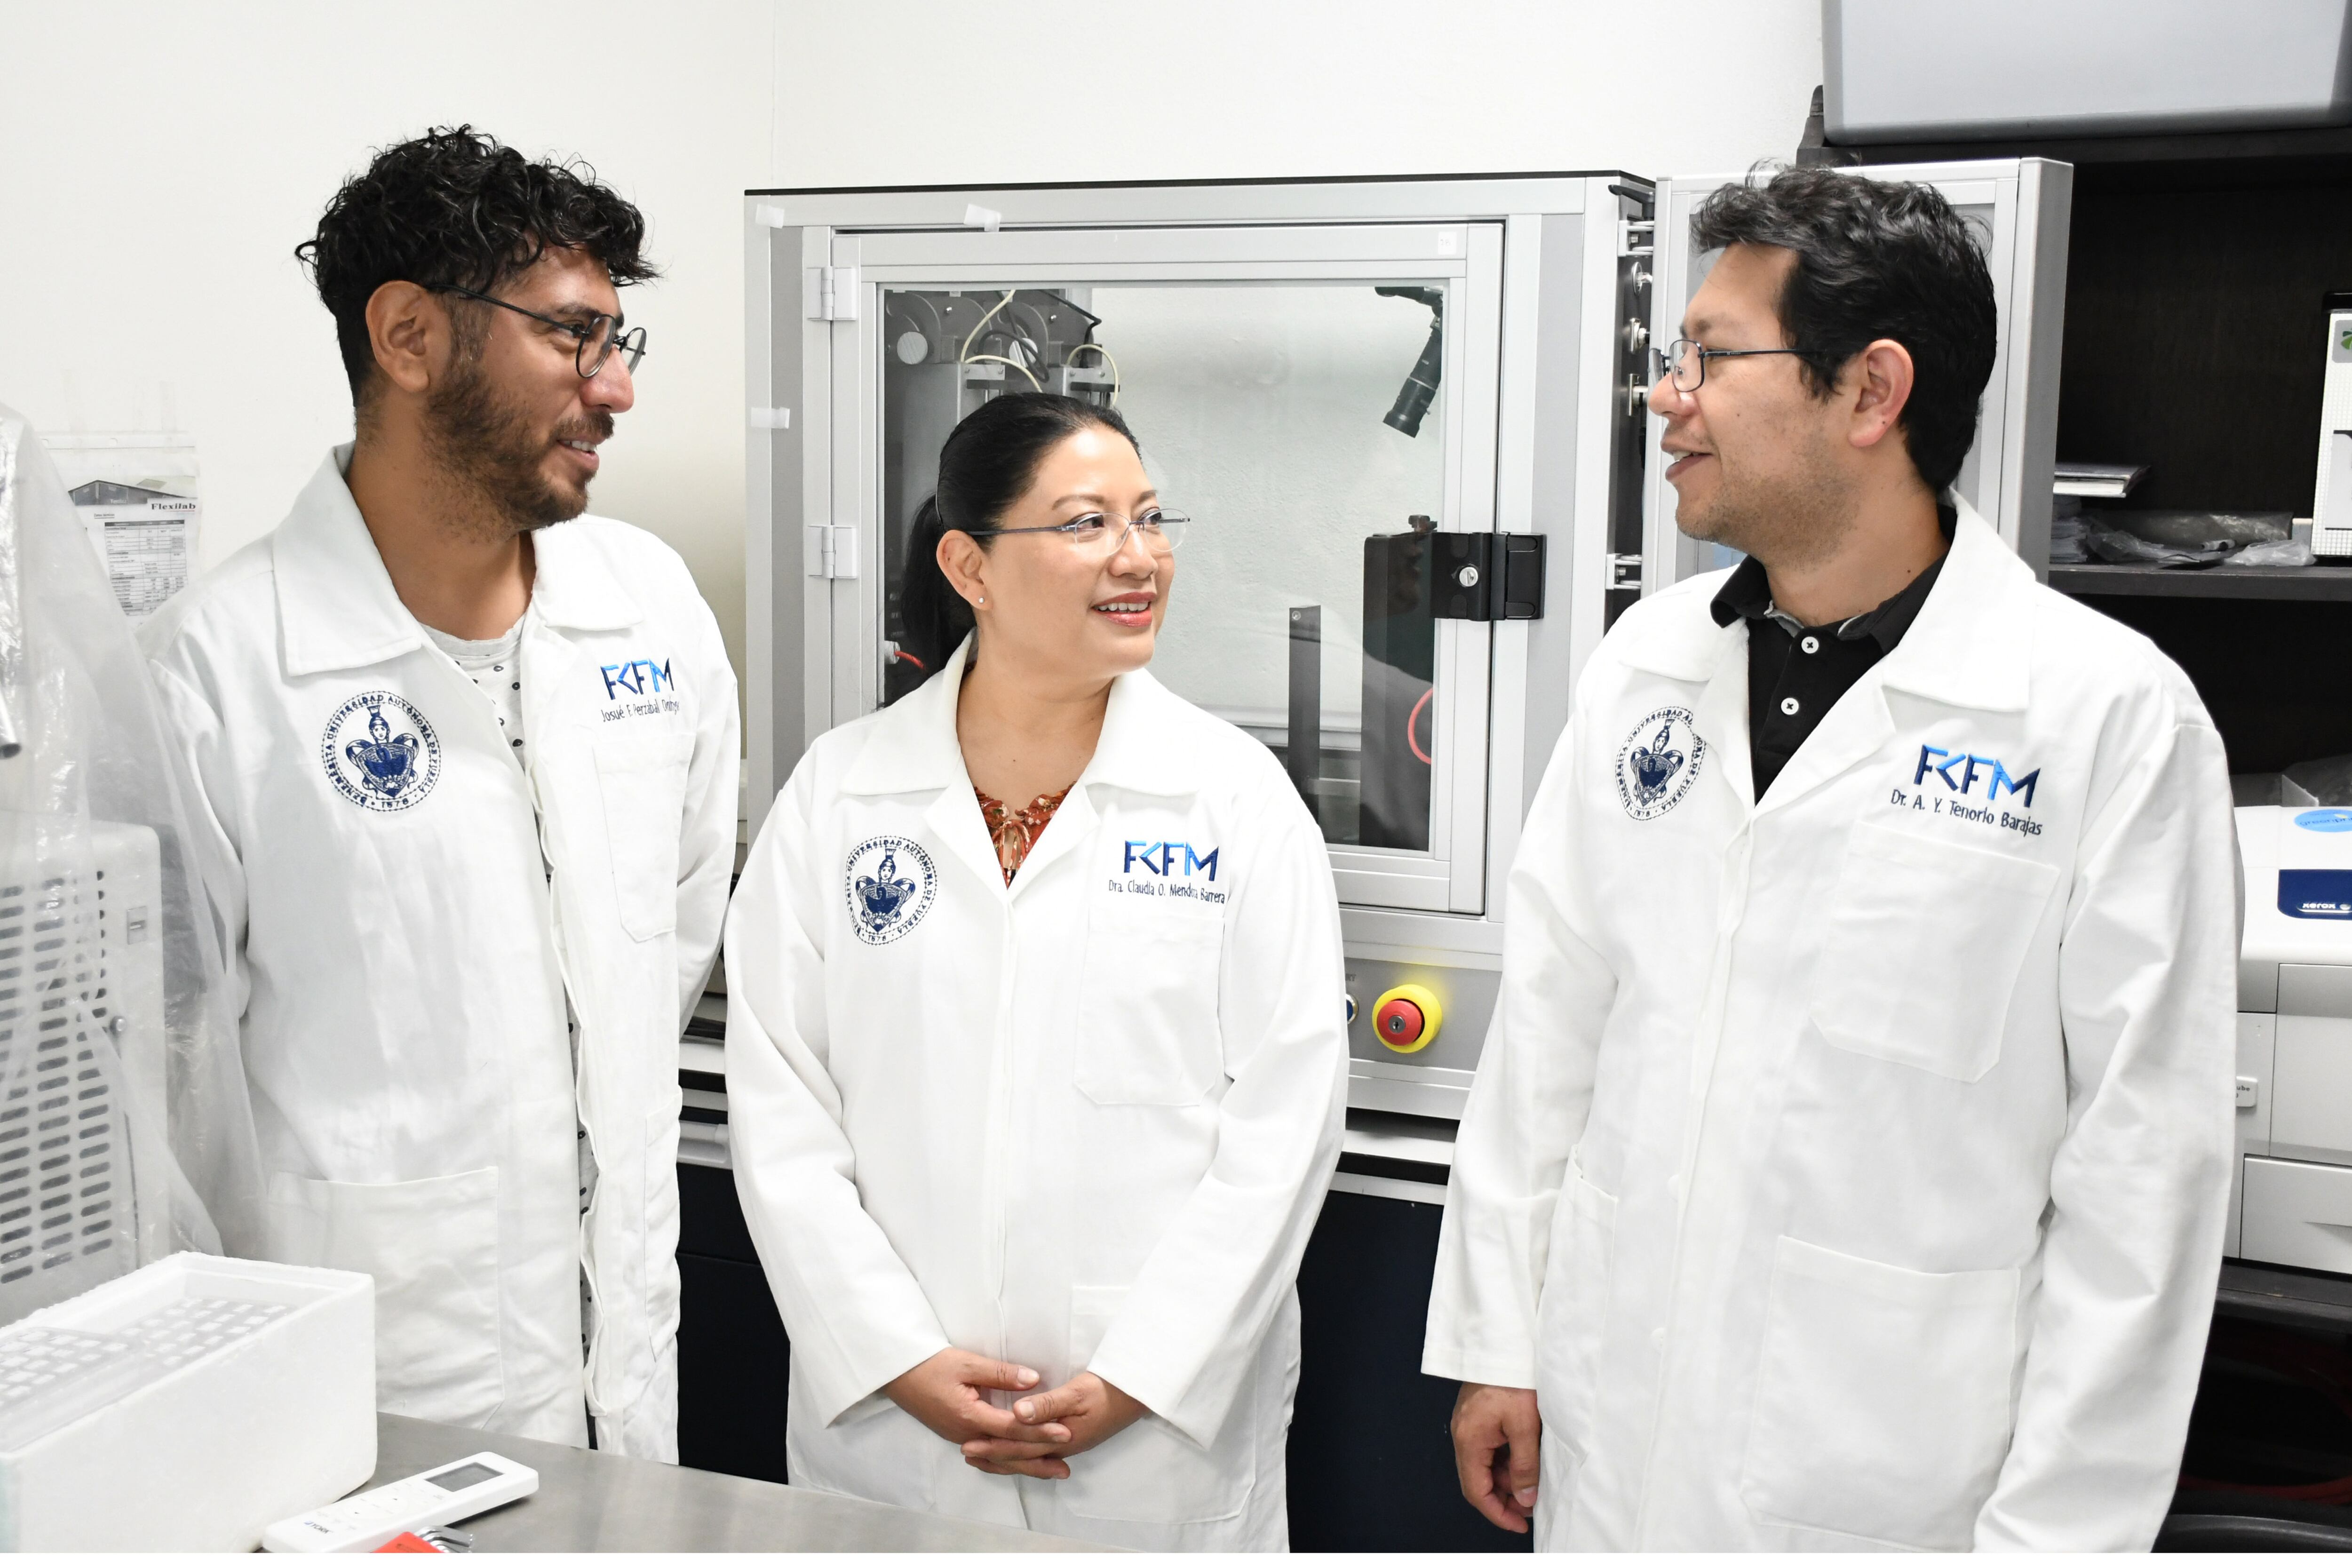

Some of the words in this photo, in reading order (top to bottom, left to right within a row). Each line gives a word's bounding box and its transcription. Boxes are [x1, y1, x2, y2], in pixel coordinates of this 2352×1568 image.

[601, 704, 625, 723] Josué
[327, 694, 384, 740] UNIVERSIDAD
[419, 758, 438, 793] PUEBLA
[1890, 788, 1907, 806] Dr.
[1912, 795, 1925, 810] A.
[1934, 797, 1943, 813] Y.
[1949, 800, 1995, 824] Tenorio
[2000, 812, 2043, 837] Barajas
[1108, 879, 1123, 893] Dra.
[1128, 879, 1154, 896] Claudia
[1158, 883, 1166, 896] O.
[1200, 887, 1225, 905] Barrera
[897, 904, 927, 934] PUEBLA
[310, 1523, 330, 1534] YORK
